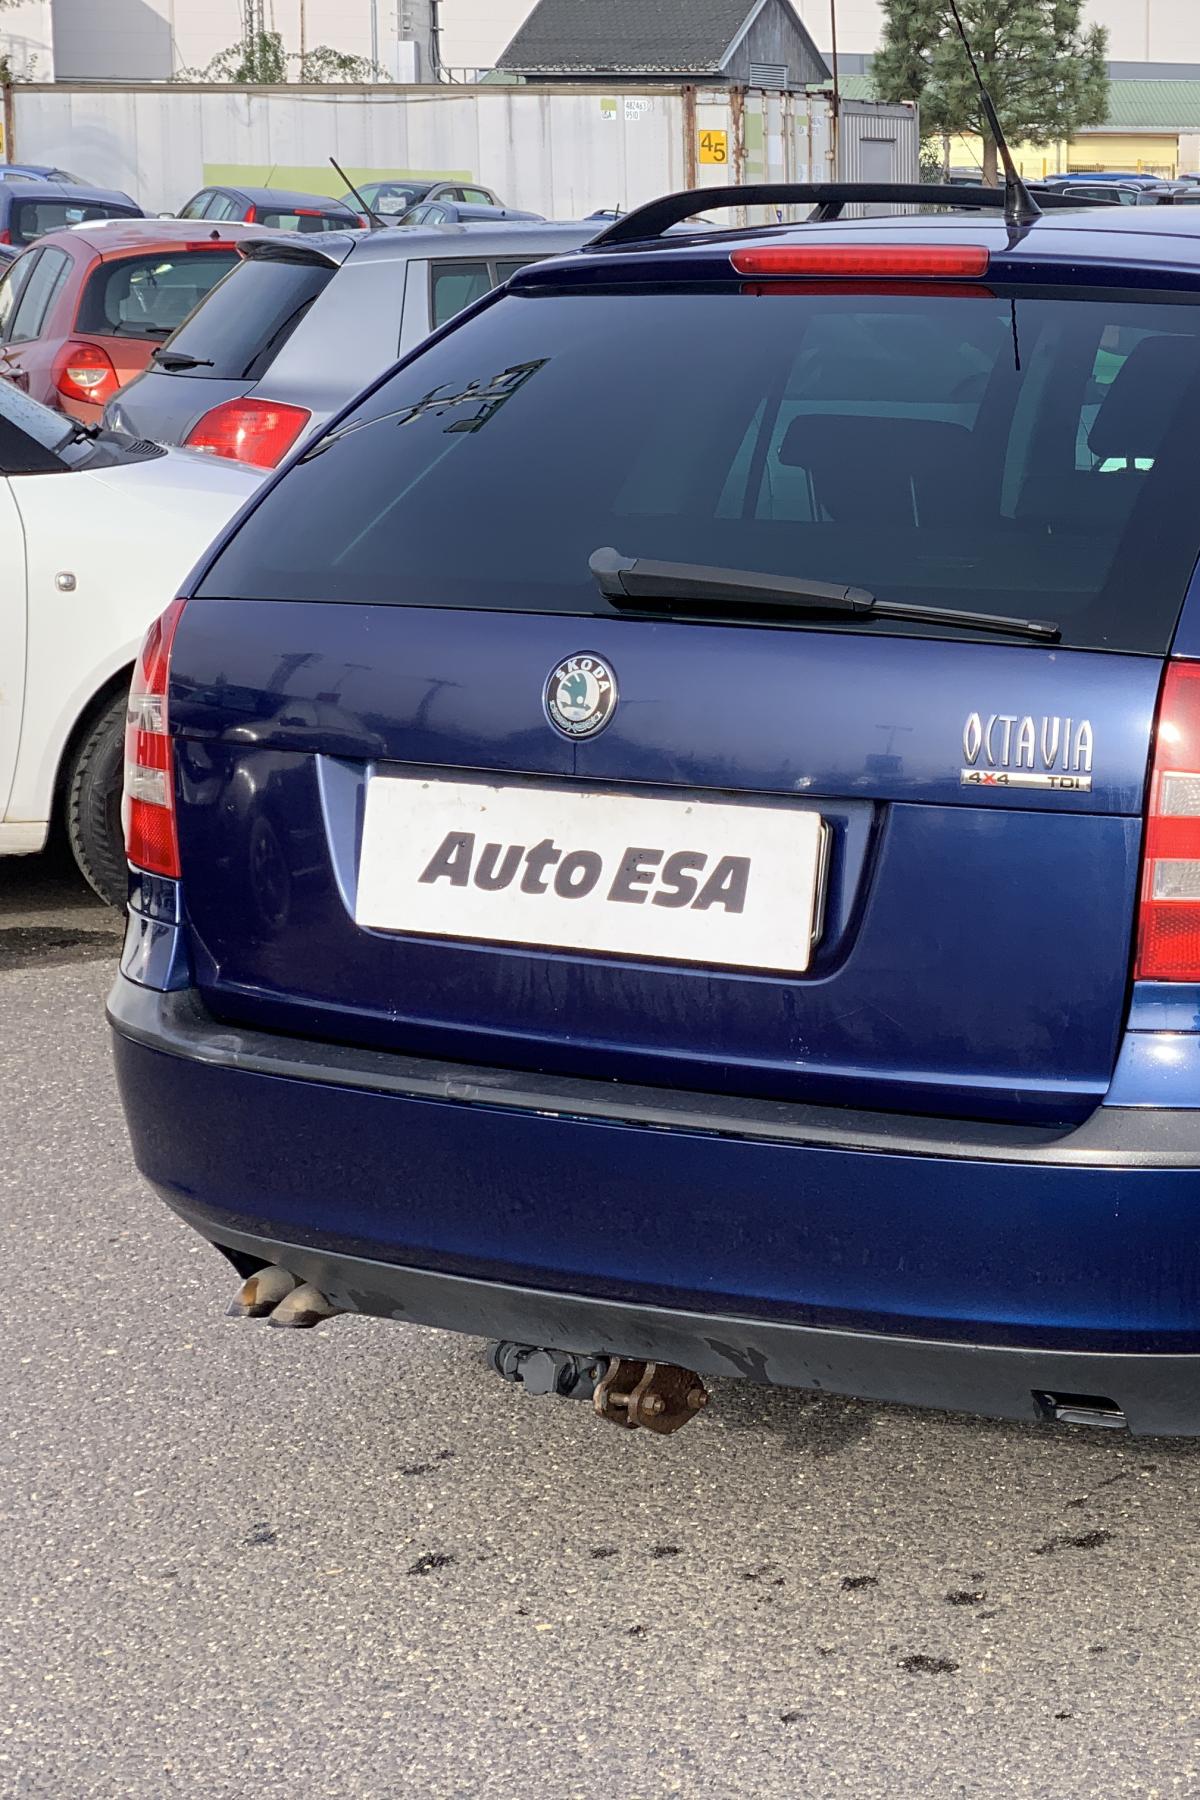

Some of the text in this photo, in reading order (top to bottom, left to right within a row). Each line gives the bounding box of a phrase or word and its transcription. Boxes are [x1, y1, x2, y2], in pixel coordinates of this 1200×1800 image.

[962, 712, 1094, 772] OCTAVIA
[1047, 776, 1080, 789] TDI
[418, 831, 751, 914] Auto ESA
